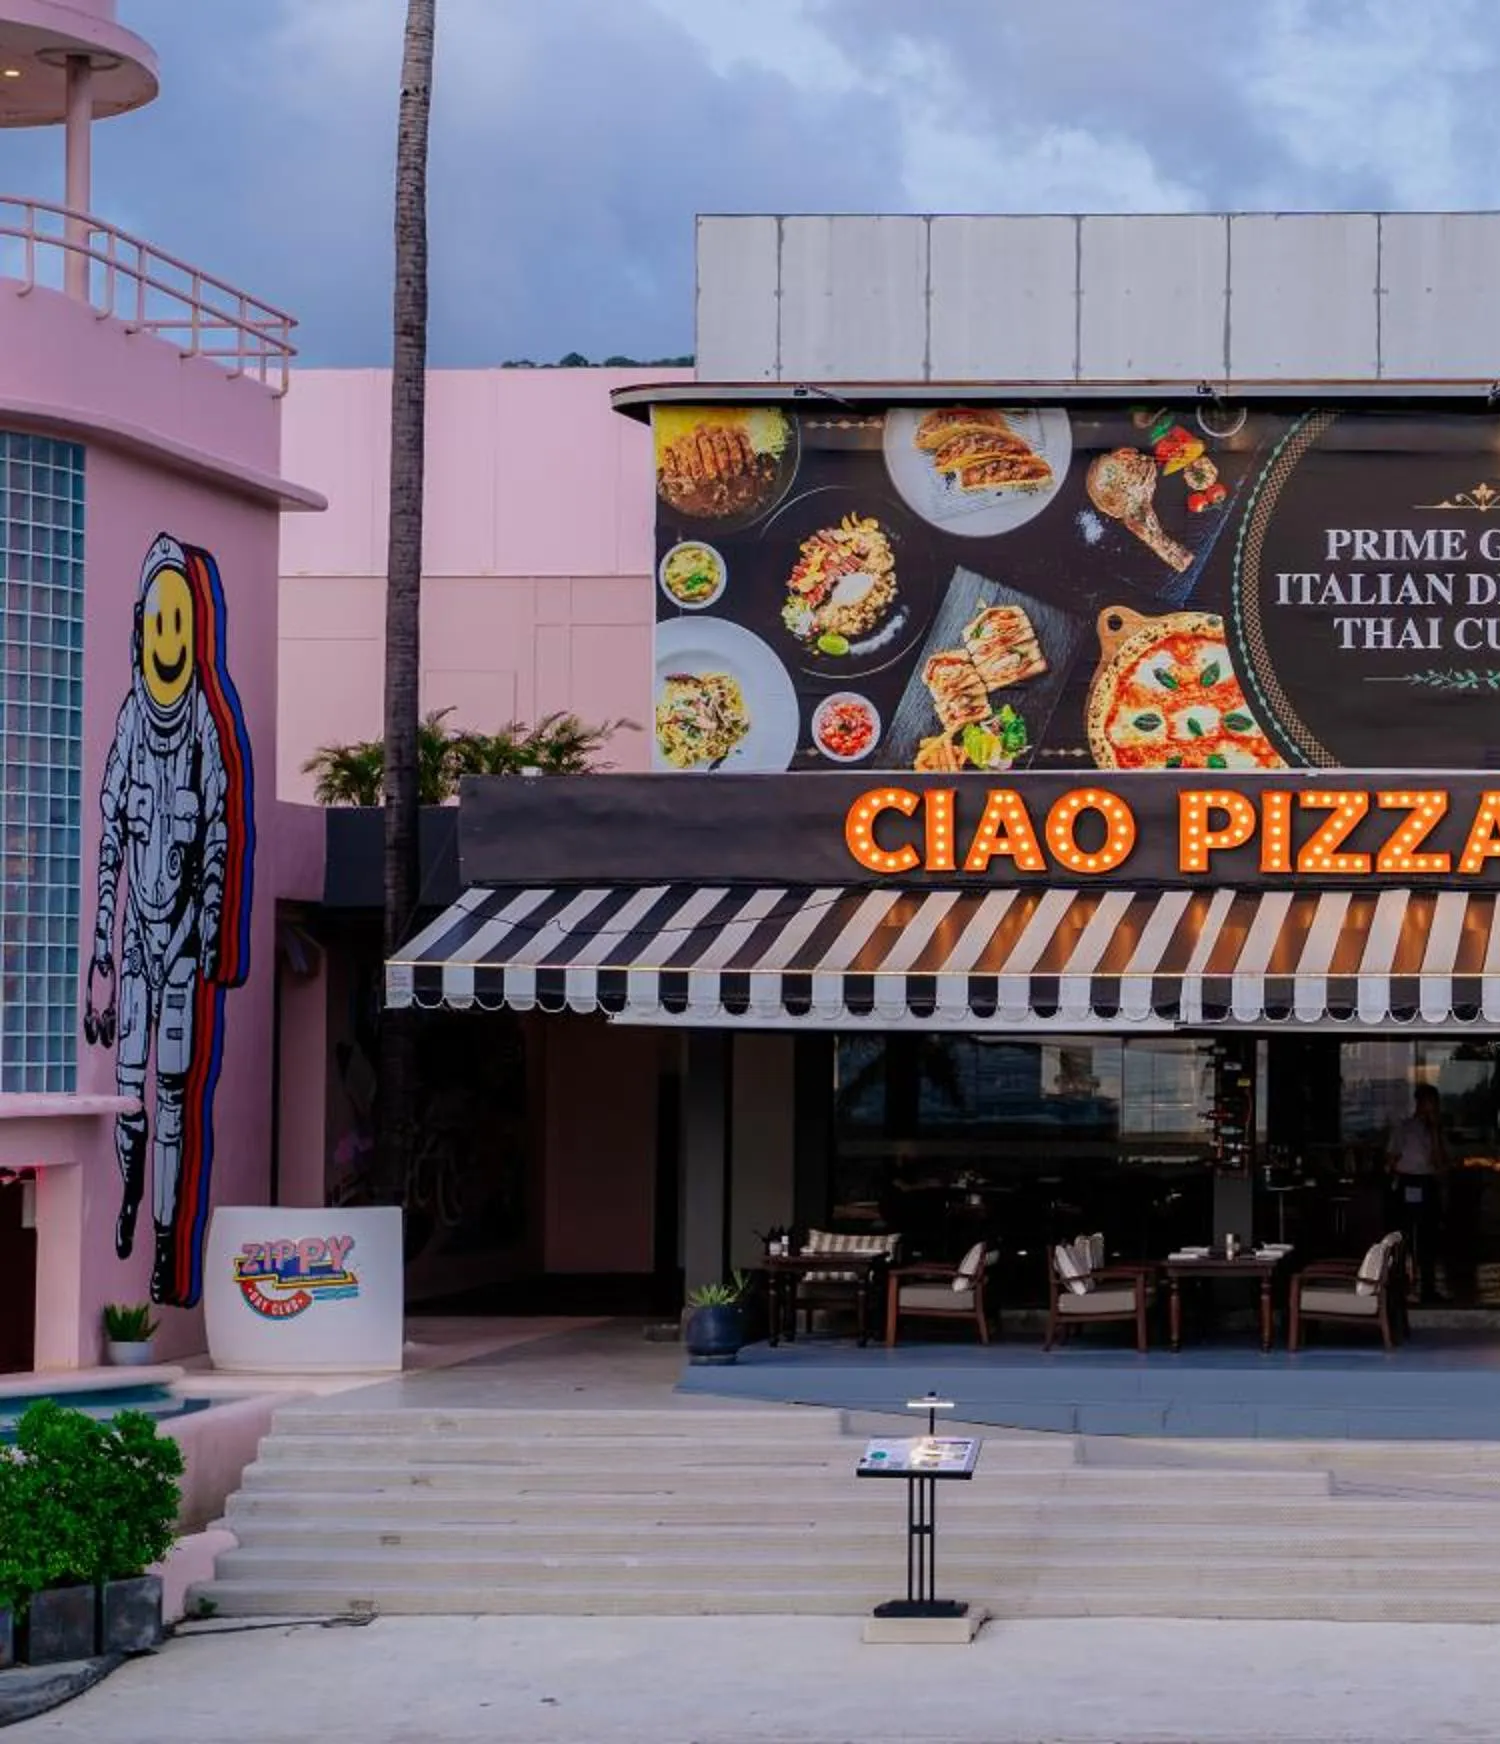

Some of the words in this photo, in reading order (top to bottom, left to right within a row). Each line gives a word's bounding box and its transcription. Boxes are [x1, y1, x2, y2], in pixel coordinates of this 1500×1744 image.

[1325, 529, 1466, 561] PRIME
[1276, 573, 1455, 606] ITALIAN
[1334, 617, 1442, 650] THAI
[845, 787, 1137, 874] CIAO
[241, 1235, 356, 1274] ZIPPY
